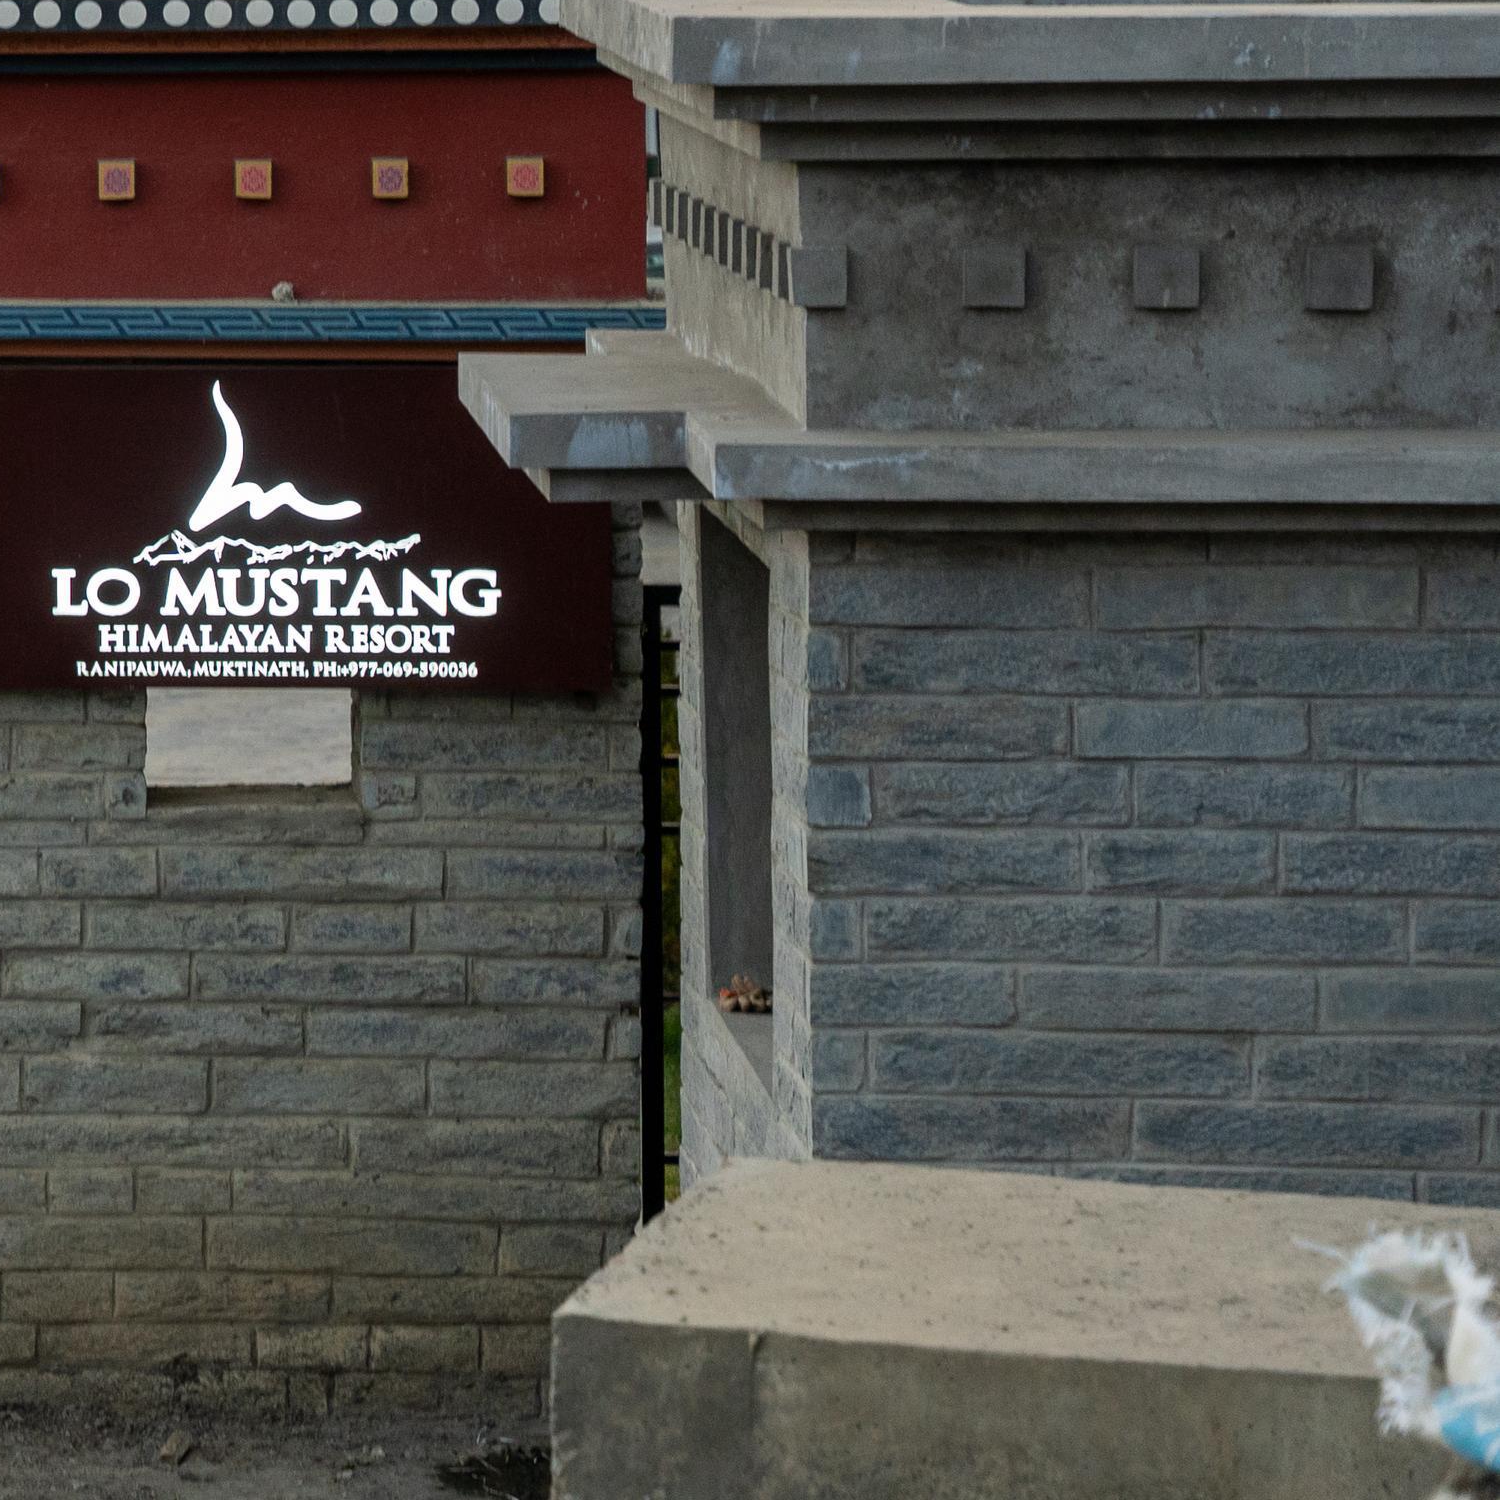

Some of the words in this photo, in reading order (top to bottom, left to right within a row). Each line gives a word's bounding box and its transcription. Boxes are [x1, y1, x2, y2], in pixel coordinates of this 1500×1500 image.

[51, 567, 141, 617] LO
[158, 567, 502, 618] MUSTANG
[98, 624, 313, 654] HIMALAYAN
[324, 624, 455, 654] RESORT
[76, 660, 192, 679] RANIPAUWA,
[192, 660, 309, 679] MUKTINATH,
